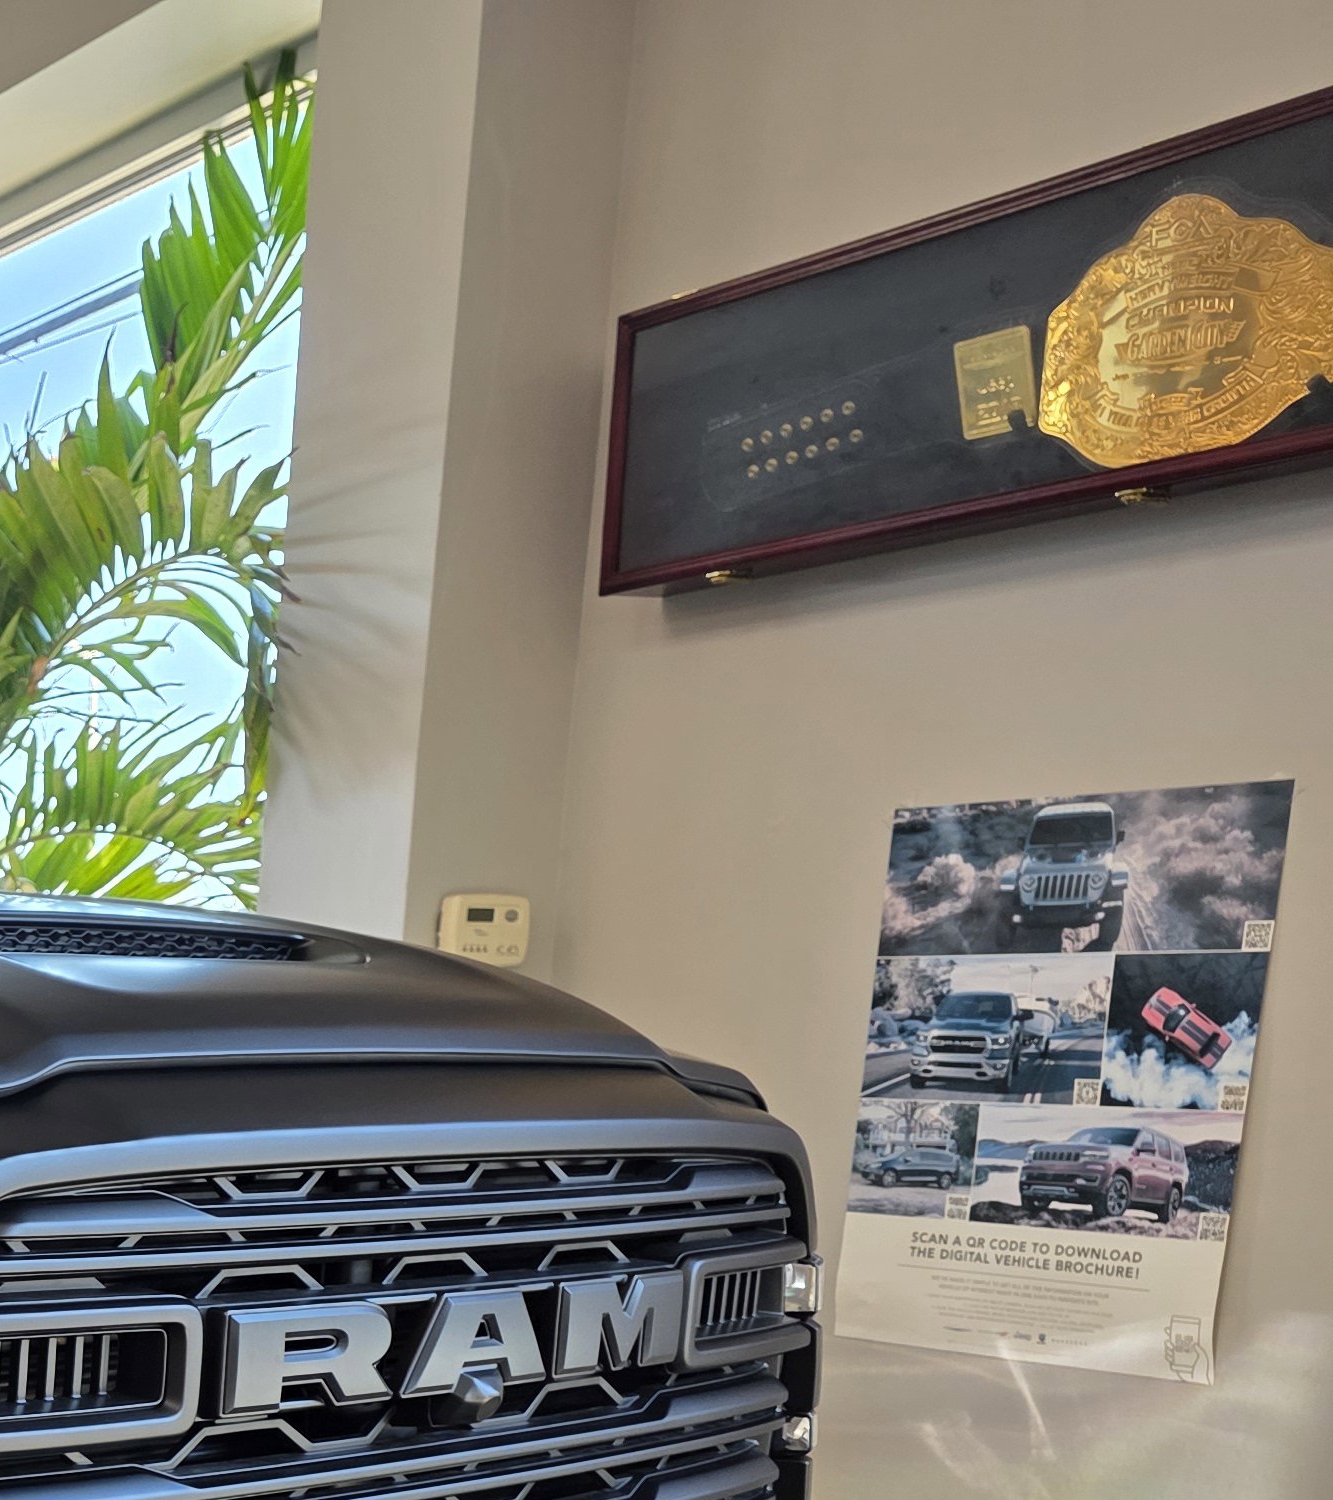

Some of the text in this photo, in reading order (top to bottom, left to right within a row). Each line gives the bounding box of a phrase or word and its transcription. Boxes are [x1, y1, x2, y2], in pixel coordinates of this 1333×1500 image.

[1126, 297, 1235, 331] CHAMPION
[1126, 324, 1190, 361] GARDEN
[909, 1245, 1141, 1280] THE DIGITAL VEHICLE BROCHURE!
[911, 1231, 1144, 1264] SCAN A QR CODE TO DOWNLOAD
[219, 1269, 685, 1420] RAM
